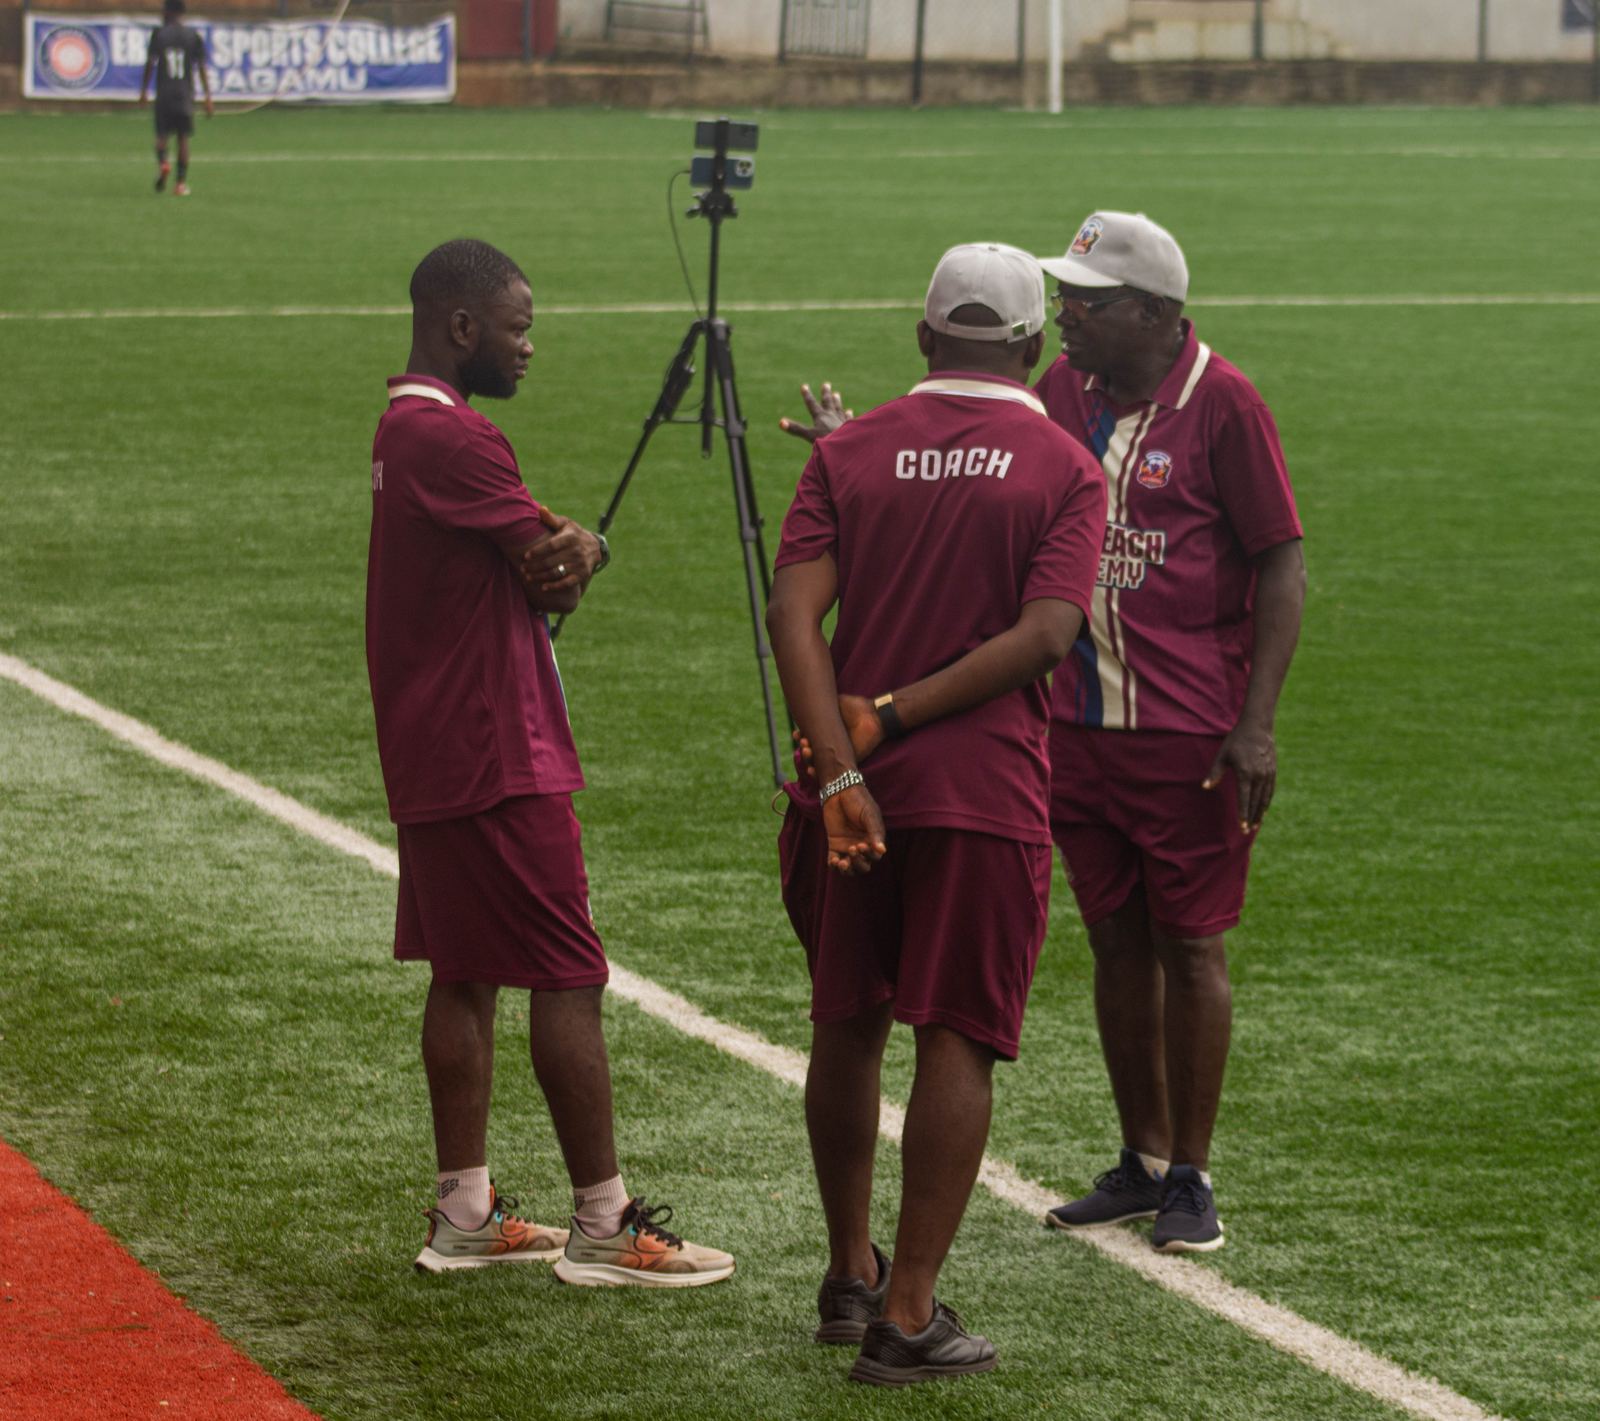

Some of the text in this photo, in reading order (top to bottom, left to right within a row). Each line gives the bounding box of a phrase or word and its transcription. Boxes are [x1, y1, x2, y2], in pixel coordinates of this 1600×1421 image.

[211, 28, 324, 69] SPORTS
[327, 26, 443, 66] COLLEGE
[896, 447, 1014, 481] COACH
[1101, 524, 1165, 565] EACH
[1097, 557, 1145, 589] EMY
